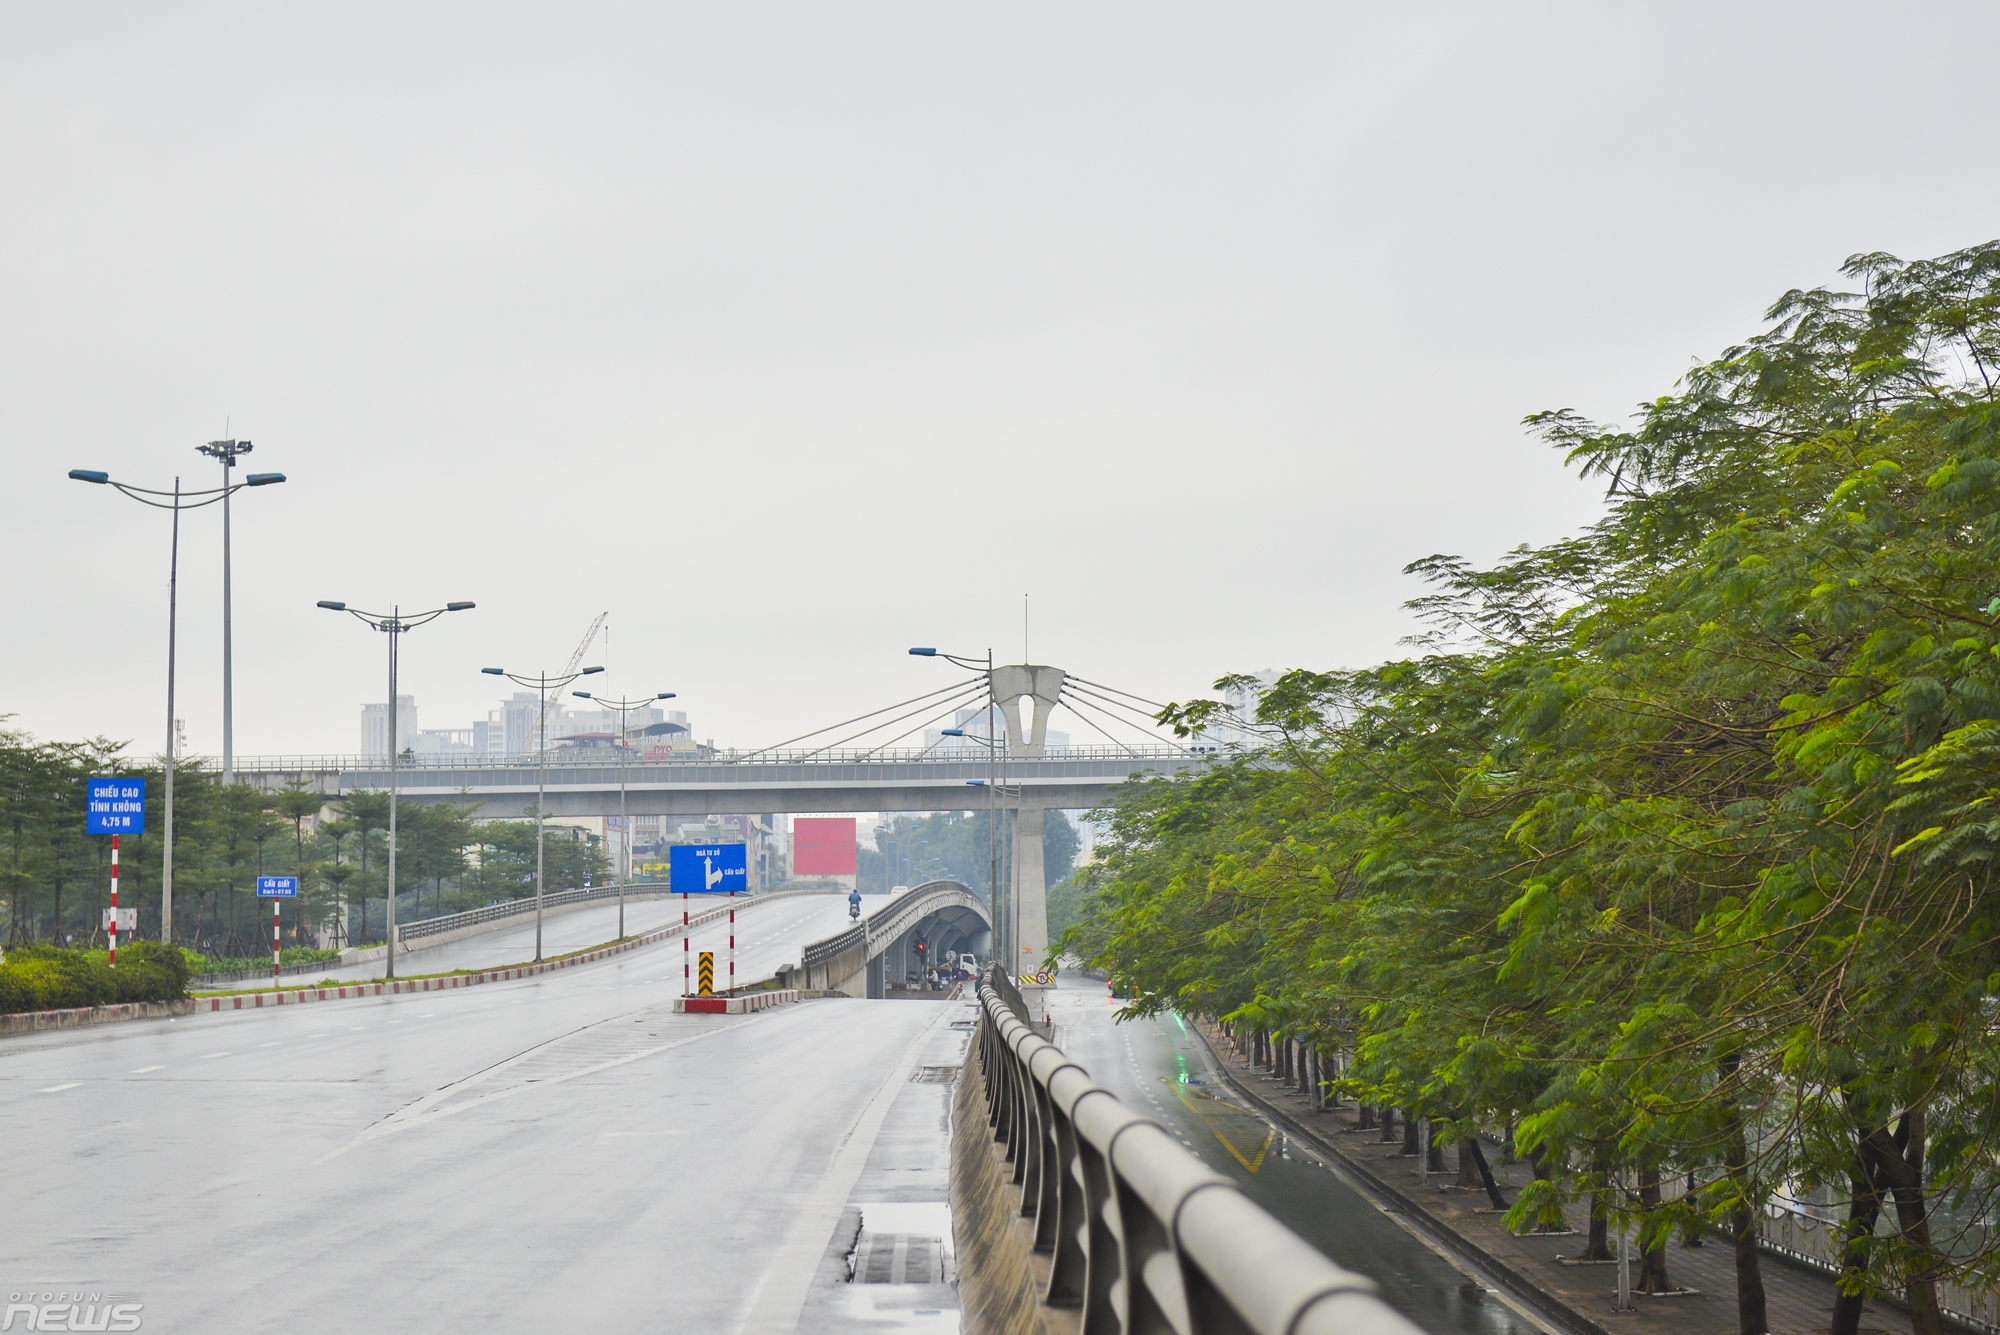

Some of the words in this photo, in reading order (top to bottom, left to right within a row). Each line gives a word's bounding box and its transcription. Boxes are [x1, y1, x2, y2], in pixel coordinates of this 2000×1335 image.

[121, 787, 139, 798] CAO
[112, 799, 142, 812] KHÔNG
[101, 816, 121, 828] 4,75
[122, 816, 131, 827] M
